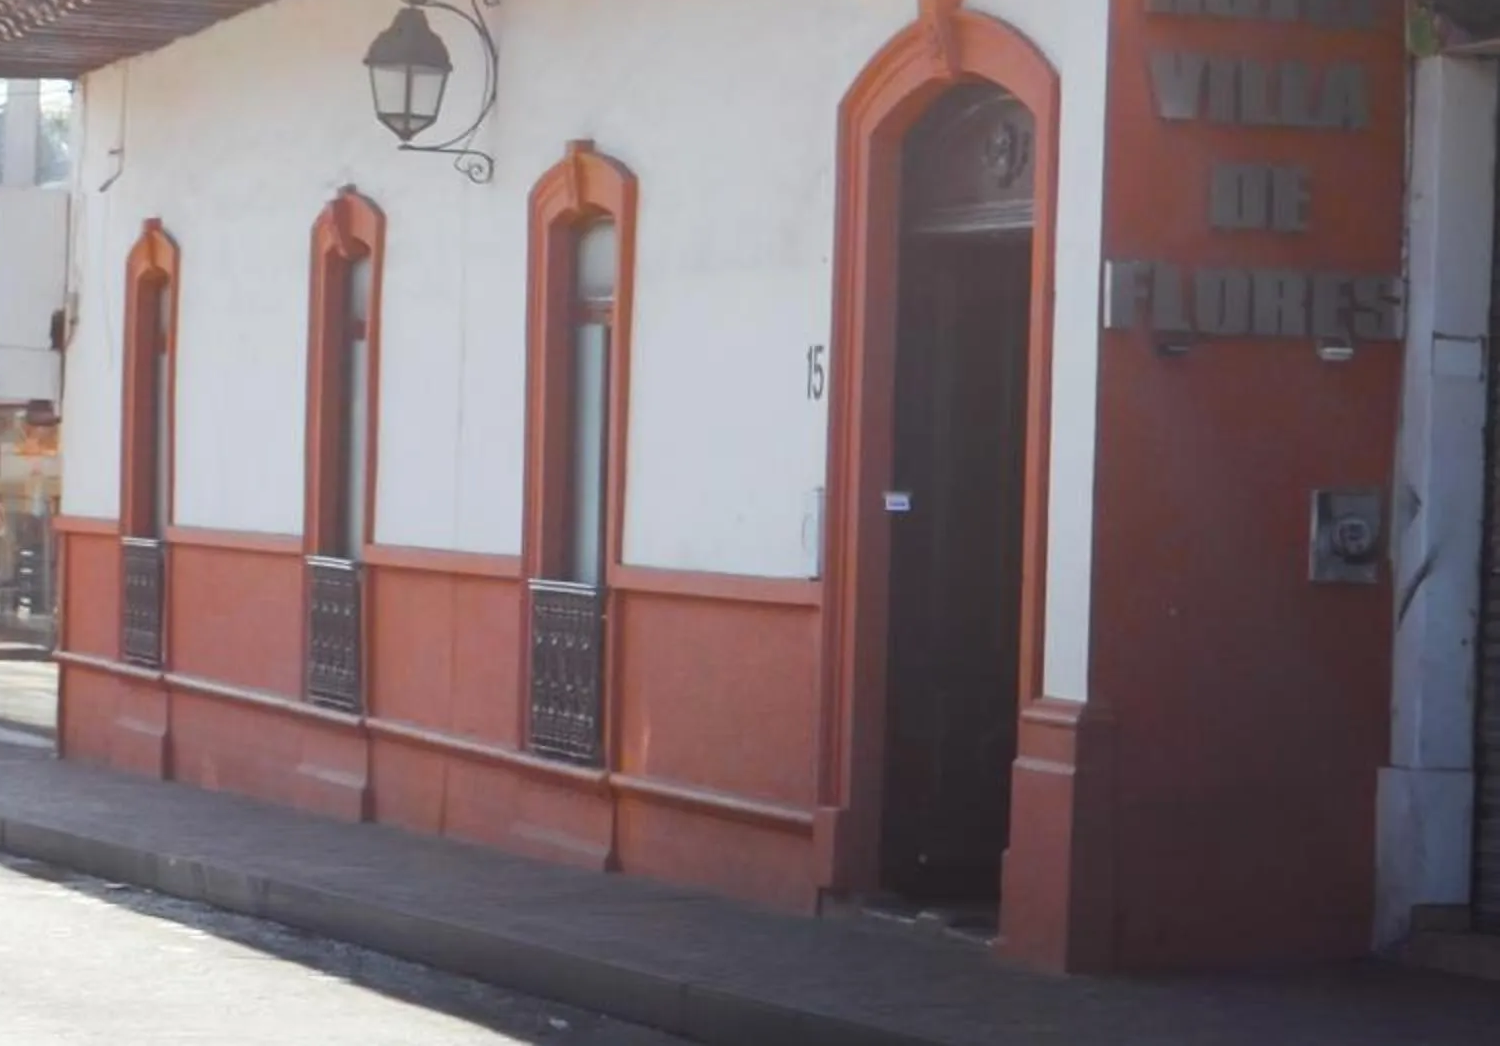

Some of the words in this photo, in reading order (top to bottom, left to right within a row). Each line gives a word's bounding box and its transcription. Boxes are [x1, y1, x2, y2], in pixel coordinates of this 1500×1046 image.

[1146, 51, 1371, 129] VILLA
[1210, 162, 1311, 235] DE
[1103, 259, 1403, 341] FLORES
[807, 345, 825, 401] 15
